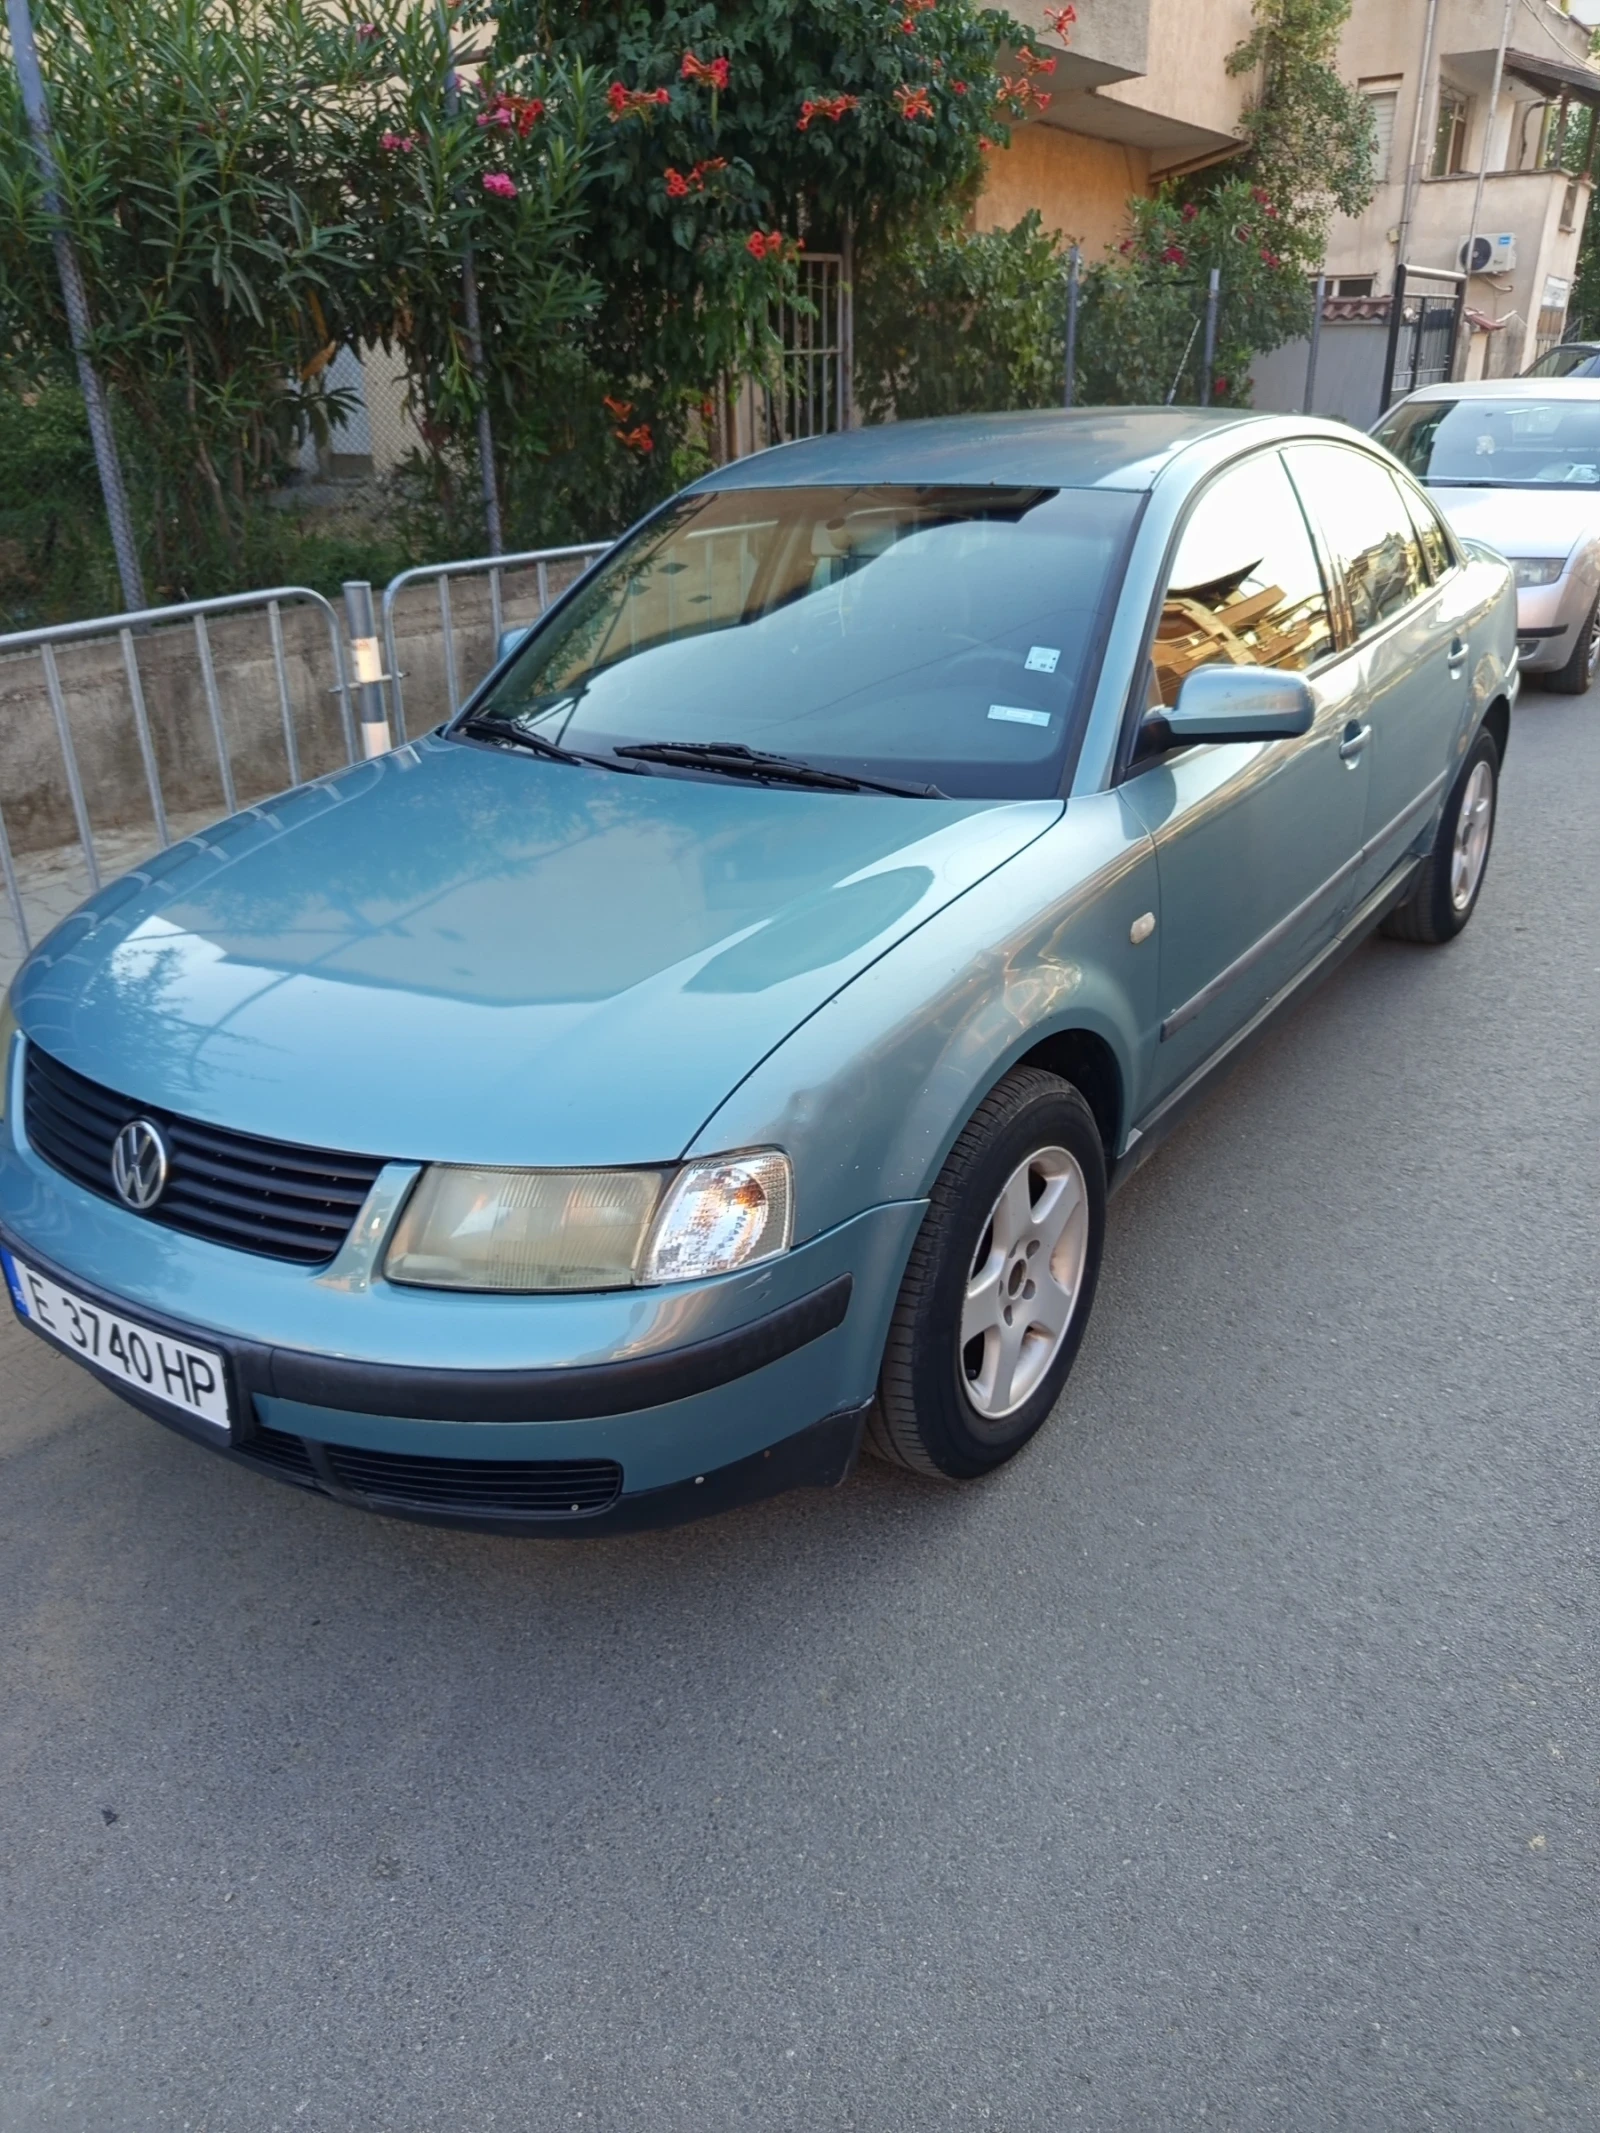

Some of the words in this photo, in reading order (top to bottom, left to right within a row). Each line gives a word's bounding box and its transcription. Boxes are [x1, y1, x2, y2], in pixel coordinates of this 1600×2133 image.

[112, 1120, 166, 1209] VW
[27, 1273, 56, 1331] E
[63, 1297, 153, 1384] 3740
[157, 1341, 215, 1407] HP
